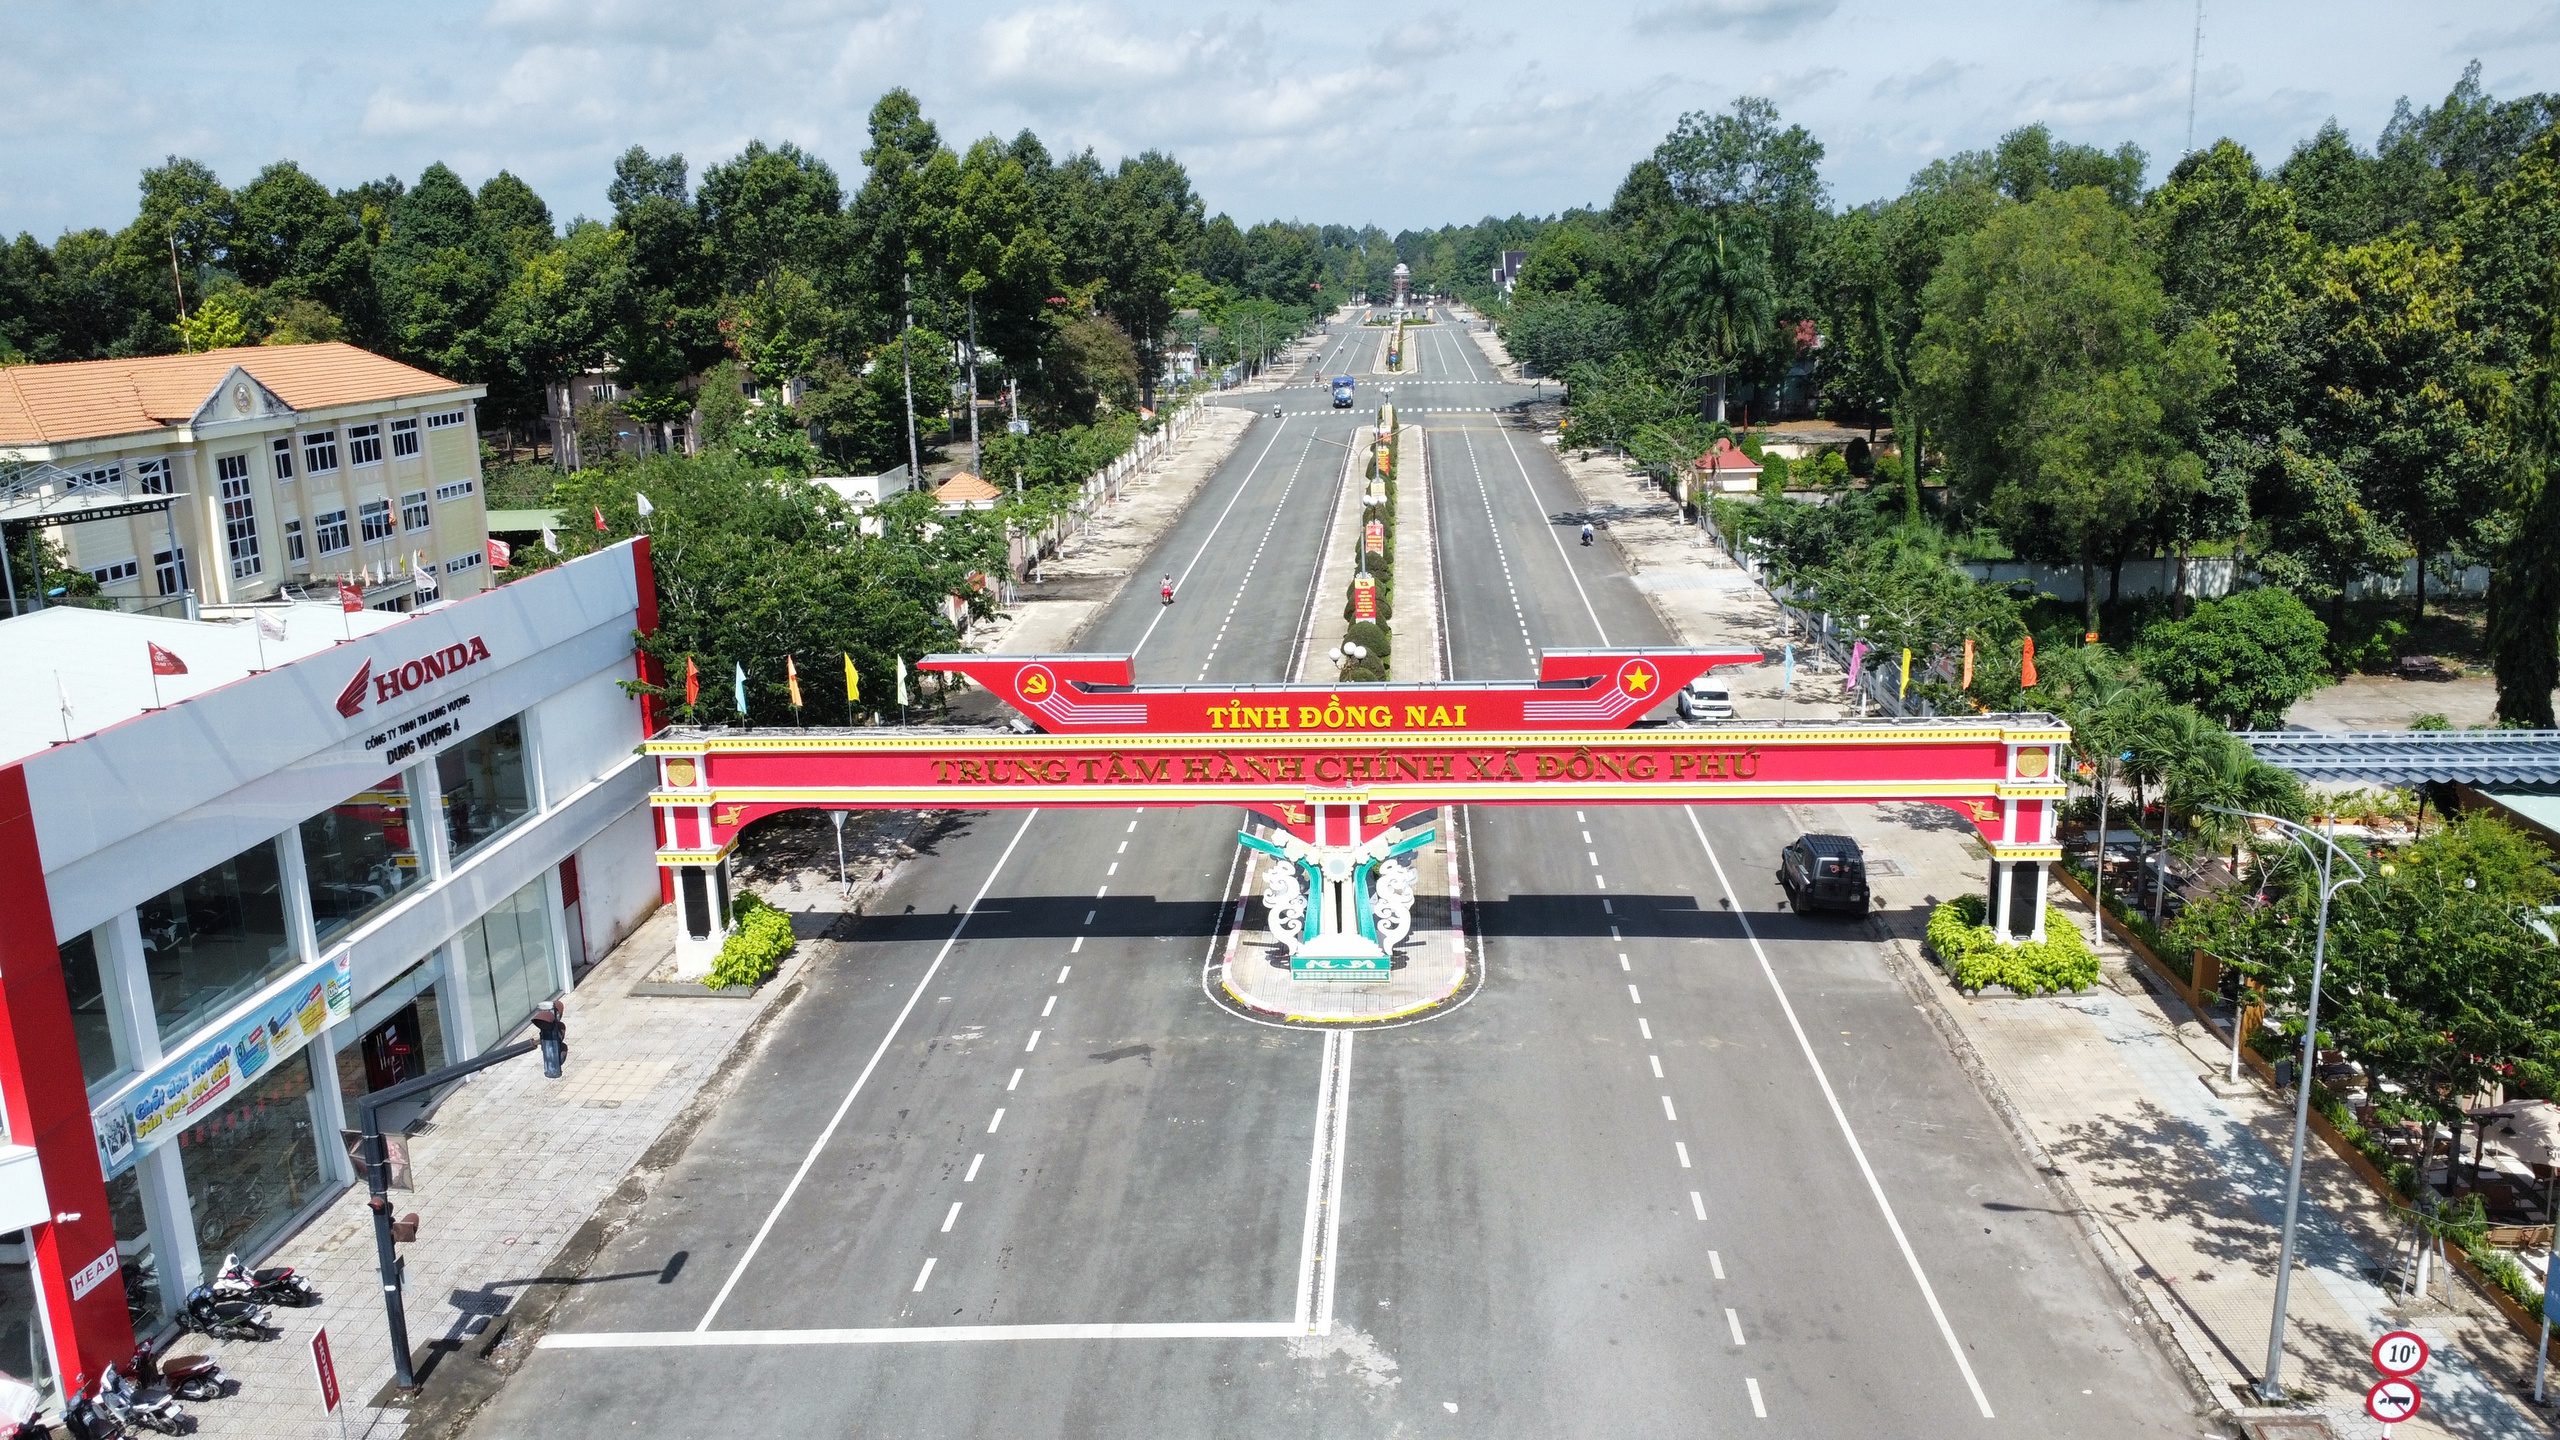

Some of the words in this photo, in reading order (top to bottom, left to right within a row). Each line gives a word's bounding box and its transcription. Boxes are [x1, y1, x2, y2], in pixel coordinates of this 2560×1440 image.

[373, 636, 491, 705] HONDA
[365, 731, 387, 750] CÔNG
[387, 727, 398, 740] TY
[447, 694, 471, 711] VƯỢNG
[1206, 699, 1290, 729] TỈNH
[1298, 694, 1393, 728] ĐỒNG
[1405, 705, 1467, 727] NAI
[386, 740, 416, 765] DUNG
[416, 722, 452, 749] VƯỢNG
[453, 717, 461, 731] 4
[931, 758, 1070, 784] TRUNG
[1077, 751, 1172, 783] TÂM
[1182, 750, 1306, 783] HÀNH
[1314, 748, 1454, 782] CHÍNH
[1466, 746, 1523, 781] XÃ
[1535, 744, 1658, 781] ĐỒNG
[1669, 745, 1761, 780] PHÚ
[74, 1252, 115, 1292] HEAD
[318, 1338, 335, 1402] HONDA
